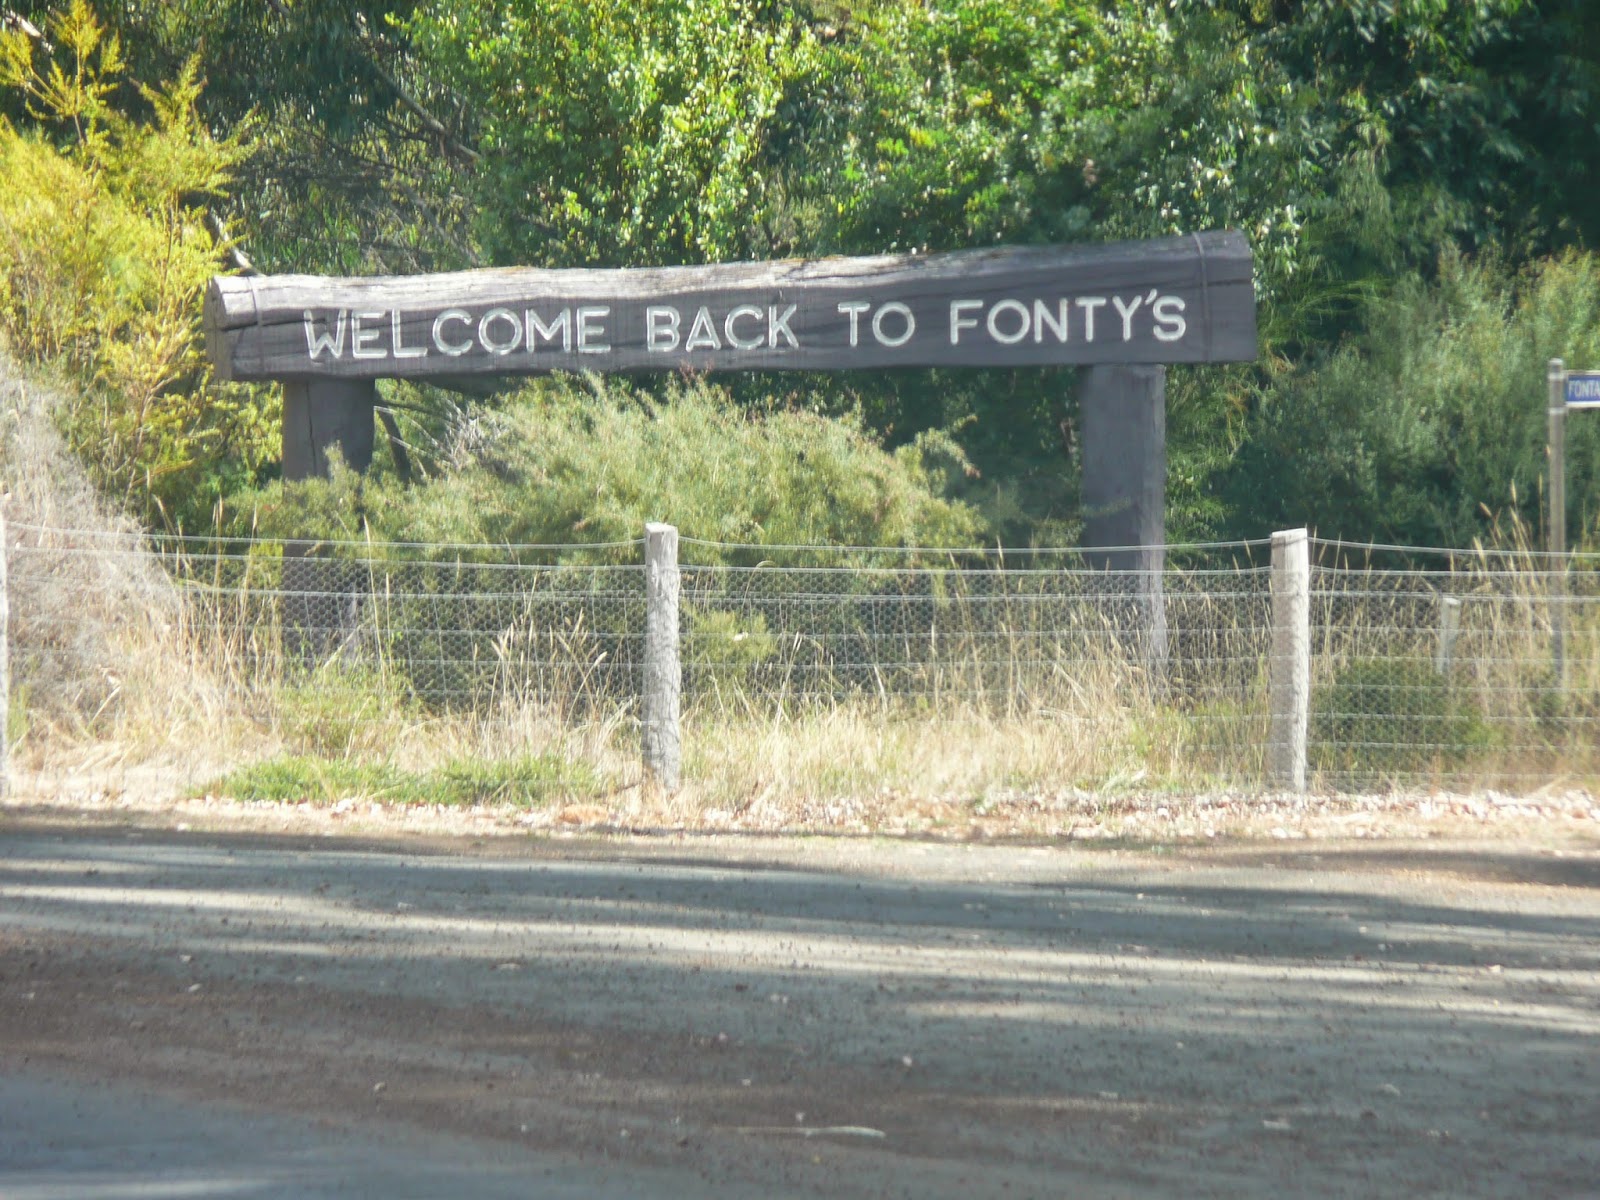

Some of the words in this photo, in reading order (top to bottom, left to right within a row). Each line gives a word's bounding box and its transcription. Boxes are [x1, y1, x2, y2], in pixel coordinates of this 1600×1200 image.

[303, 306, 612, 360] WELCOME
[646, 303, 800, 352] BACK
[837, 301, 916, 347] TO
[950, 288, 1187, 346] FONTY'S
